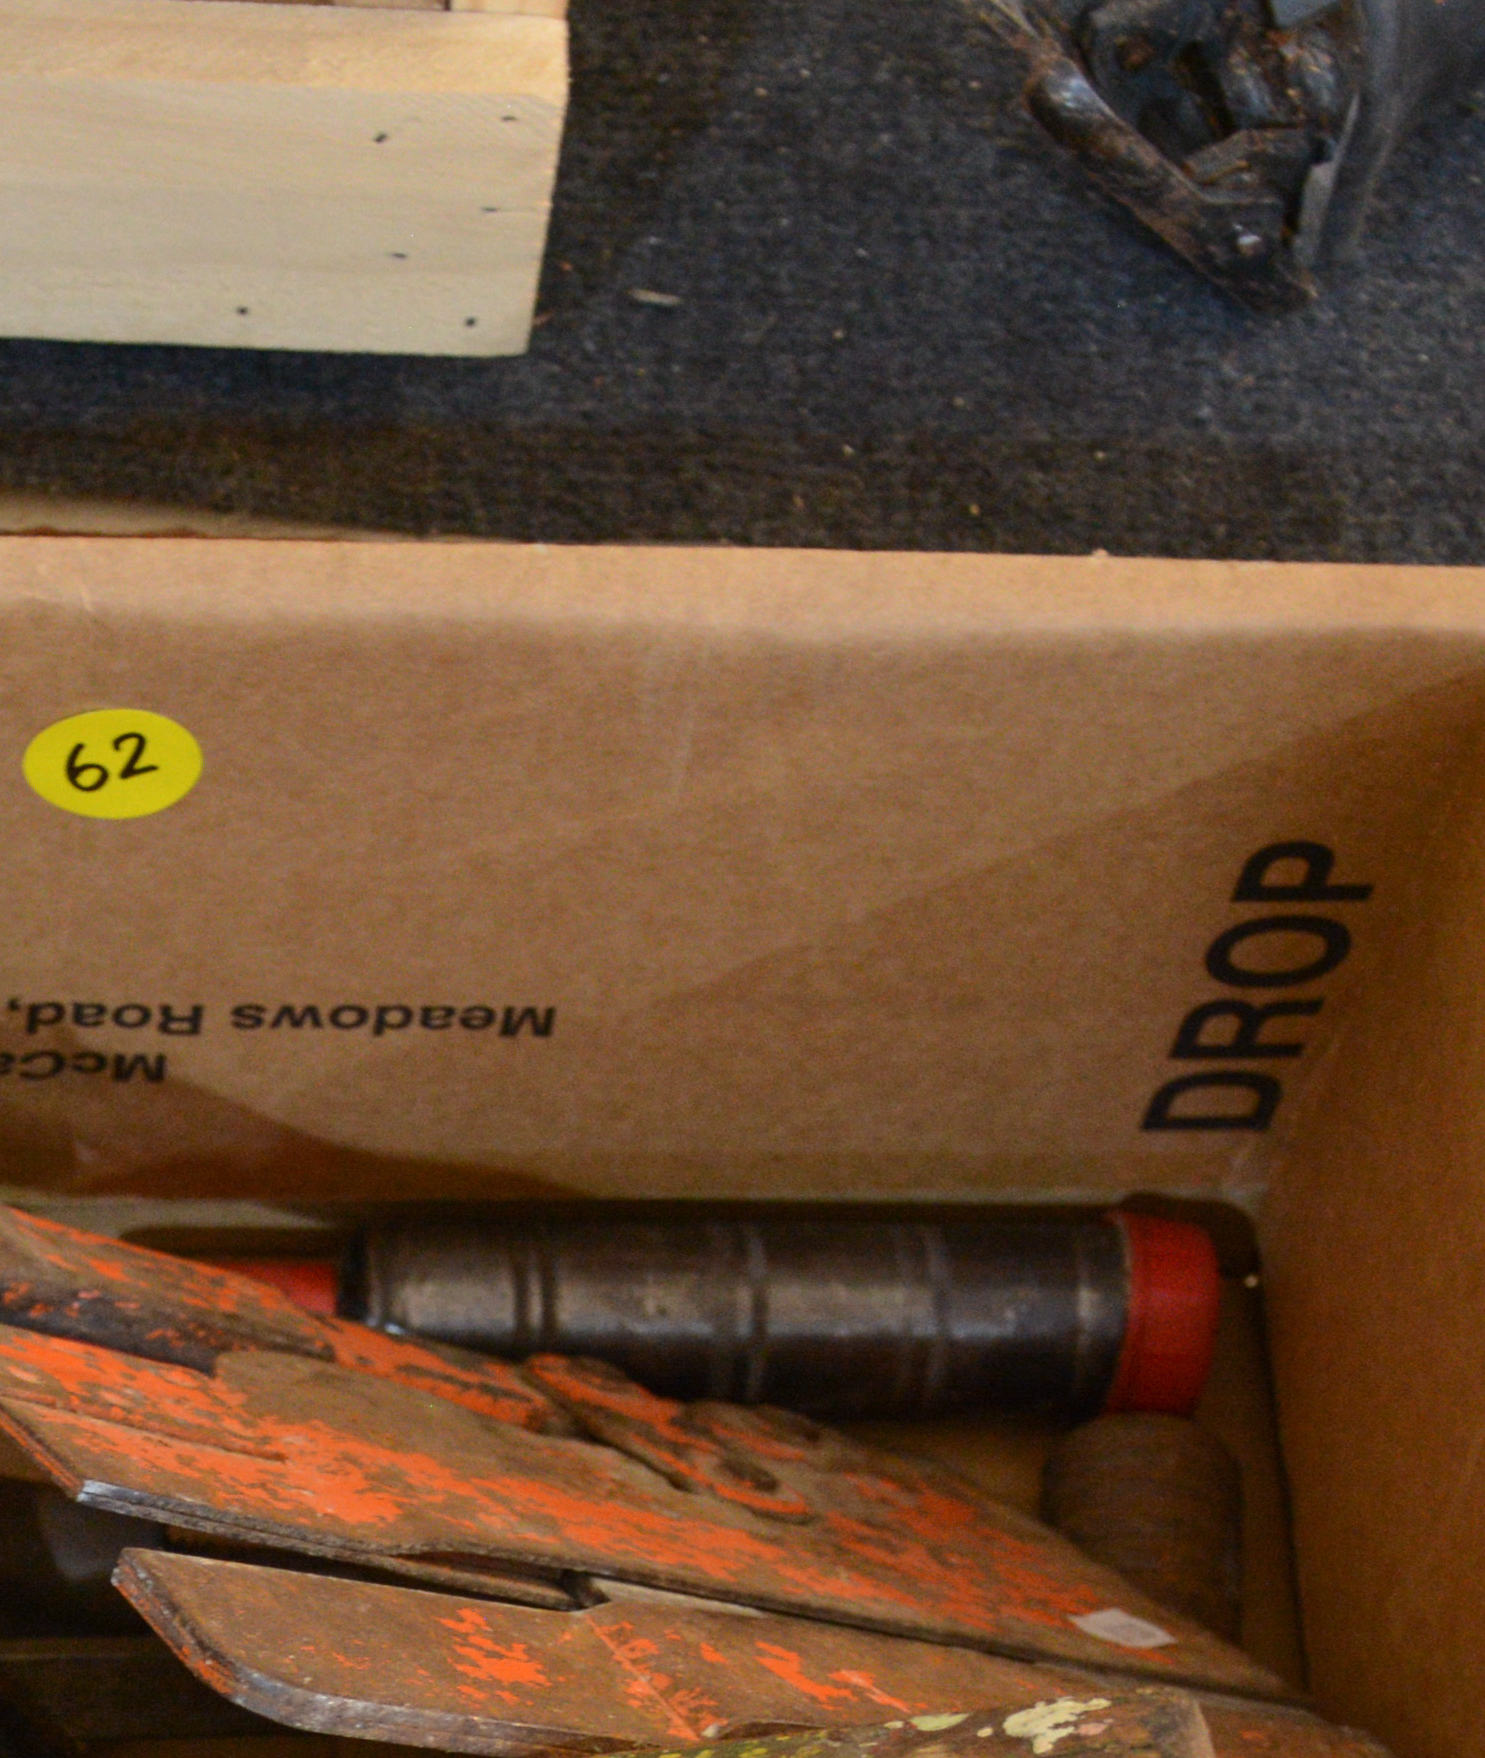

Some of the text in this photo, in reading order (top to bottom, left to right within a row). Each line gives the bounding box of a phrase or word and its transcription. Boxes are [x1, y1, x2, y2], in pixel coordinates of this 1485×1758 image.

[65, 731, 160, 792] 62
[1140, 840, 1375, 1133] DROP
[7, 997, 204, 1036] Road,
[230, 1001, 556, 1038] Meadows
